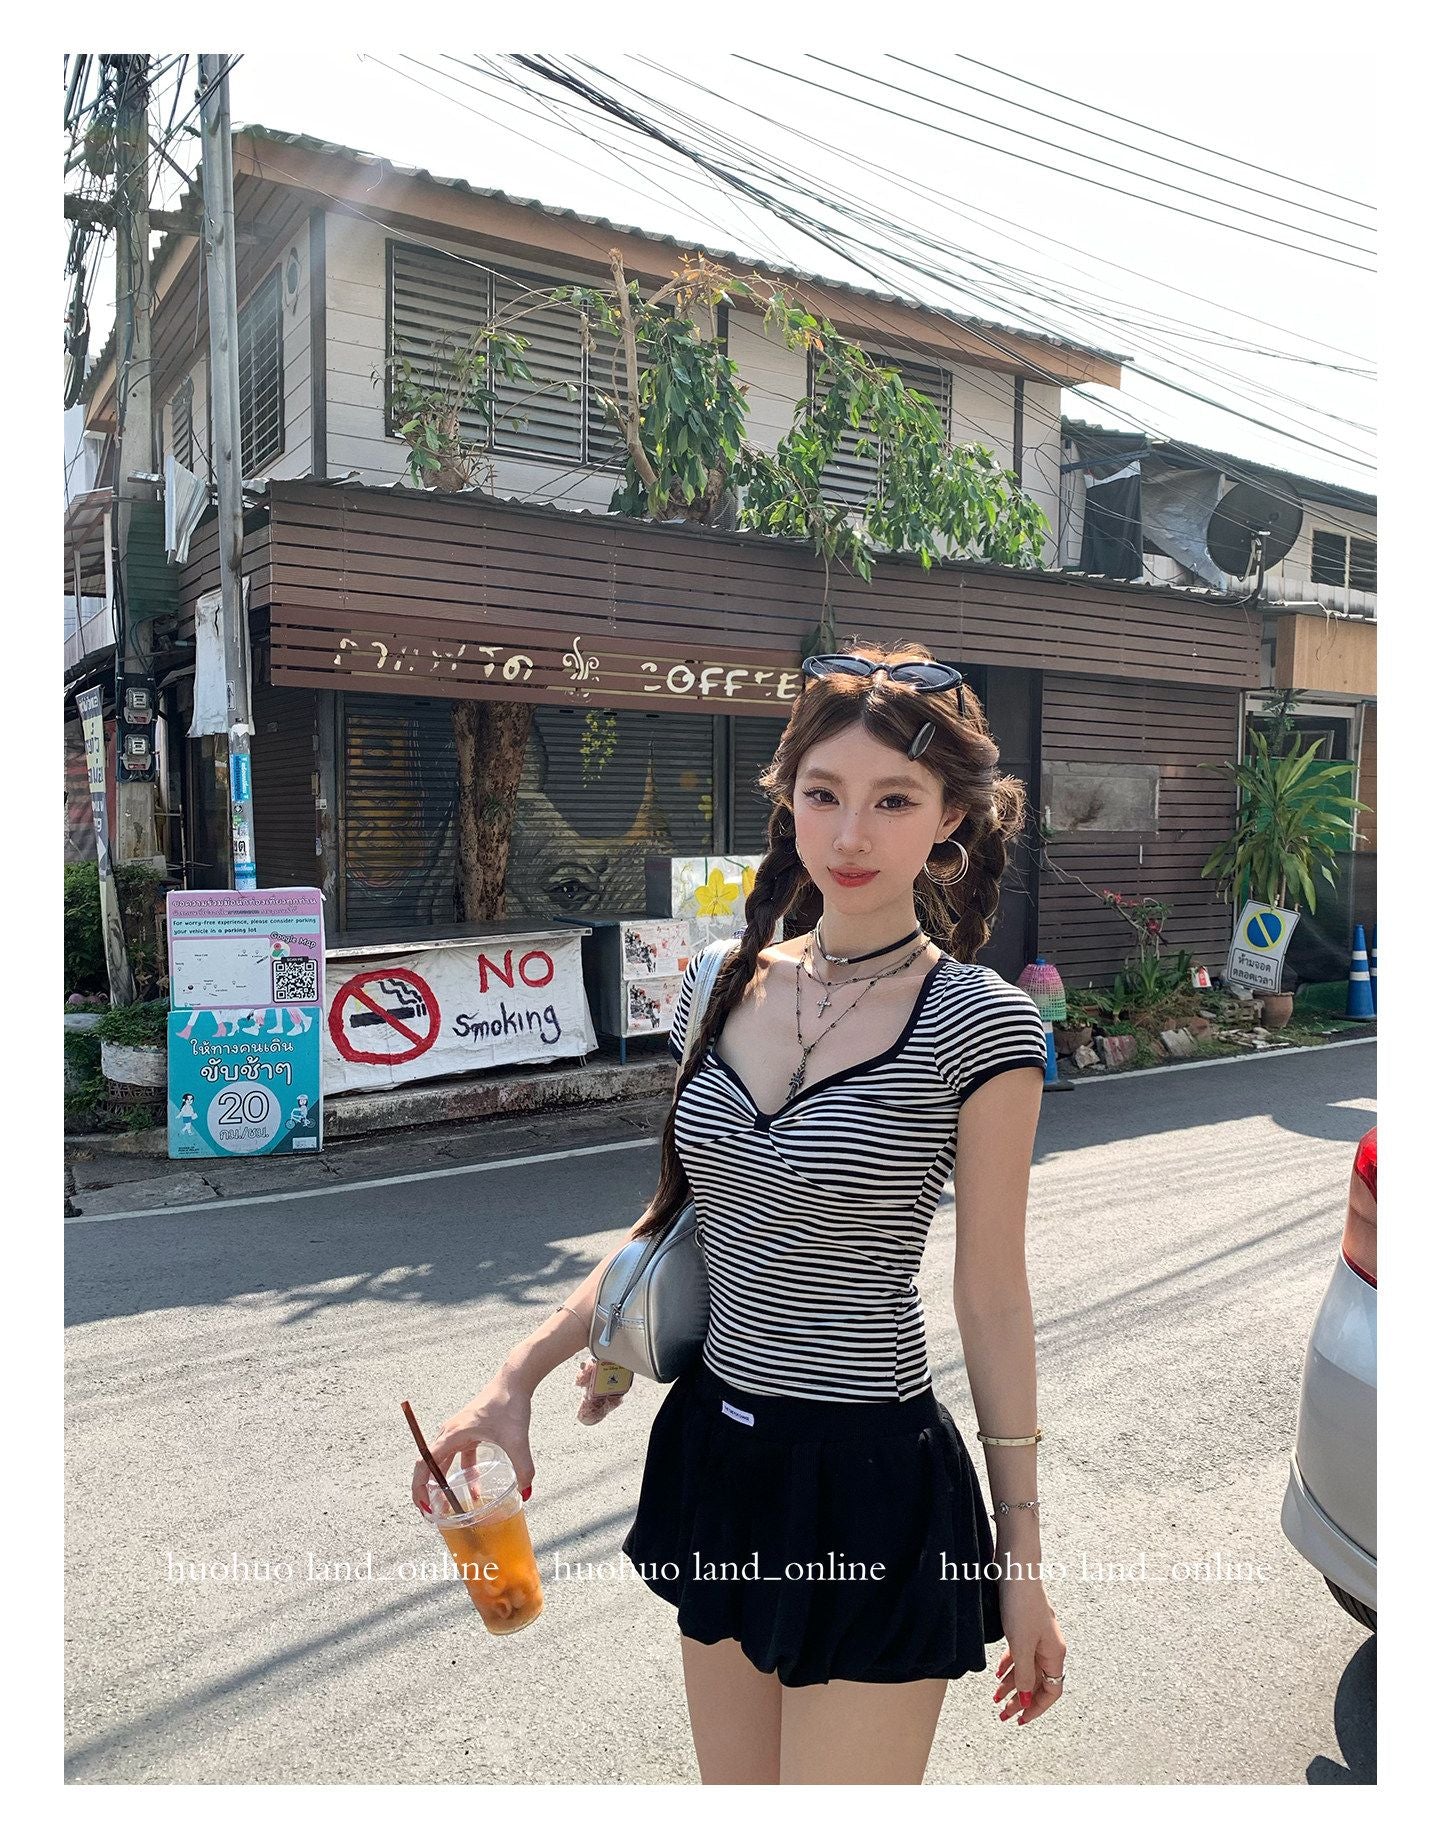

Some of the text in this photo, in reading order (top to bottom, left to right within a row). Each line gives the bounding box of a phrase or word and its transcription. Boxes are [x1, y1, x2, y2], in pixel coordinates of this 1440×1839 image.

[270, 931, 317, 949] Google Map
[477, 949, 554, 993] NO
[1238, 952, 1271, 972] ห้ามจอด
[1232, 968, 1274, 986] ตลอดเวลา
[452, 1002, 562, 1044] Smoking
[190, 1039, 294, 1056] ให้ทางคนเดิน
[200, 1056, 293, 1085] ขับช้าๆ
[218, 1090, 270, 1125] 20
[219, 1126, 270, 1140] กม./ชม.
